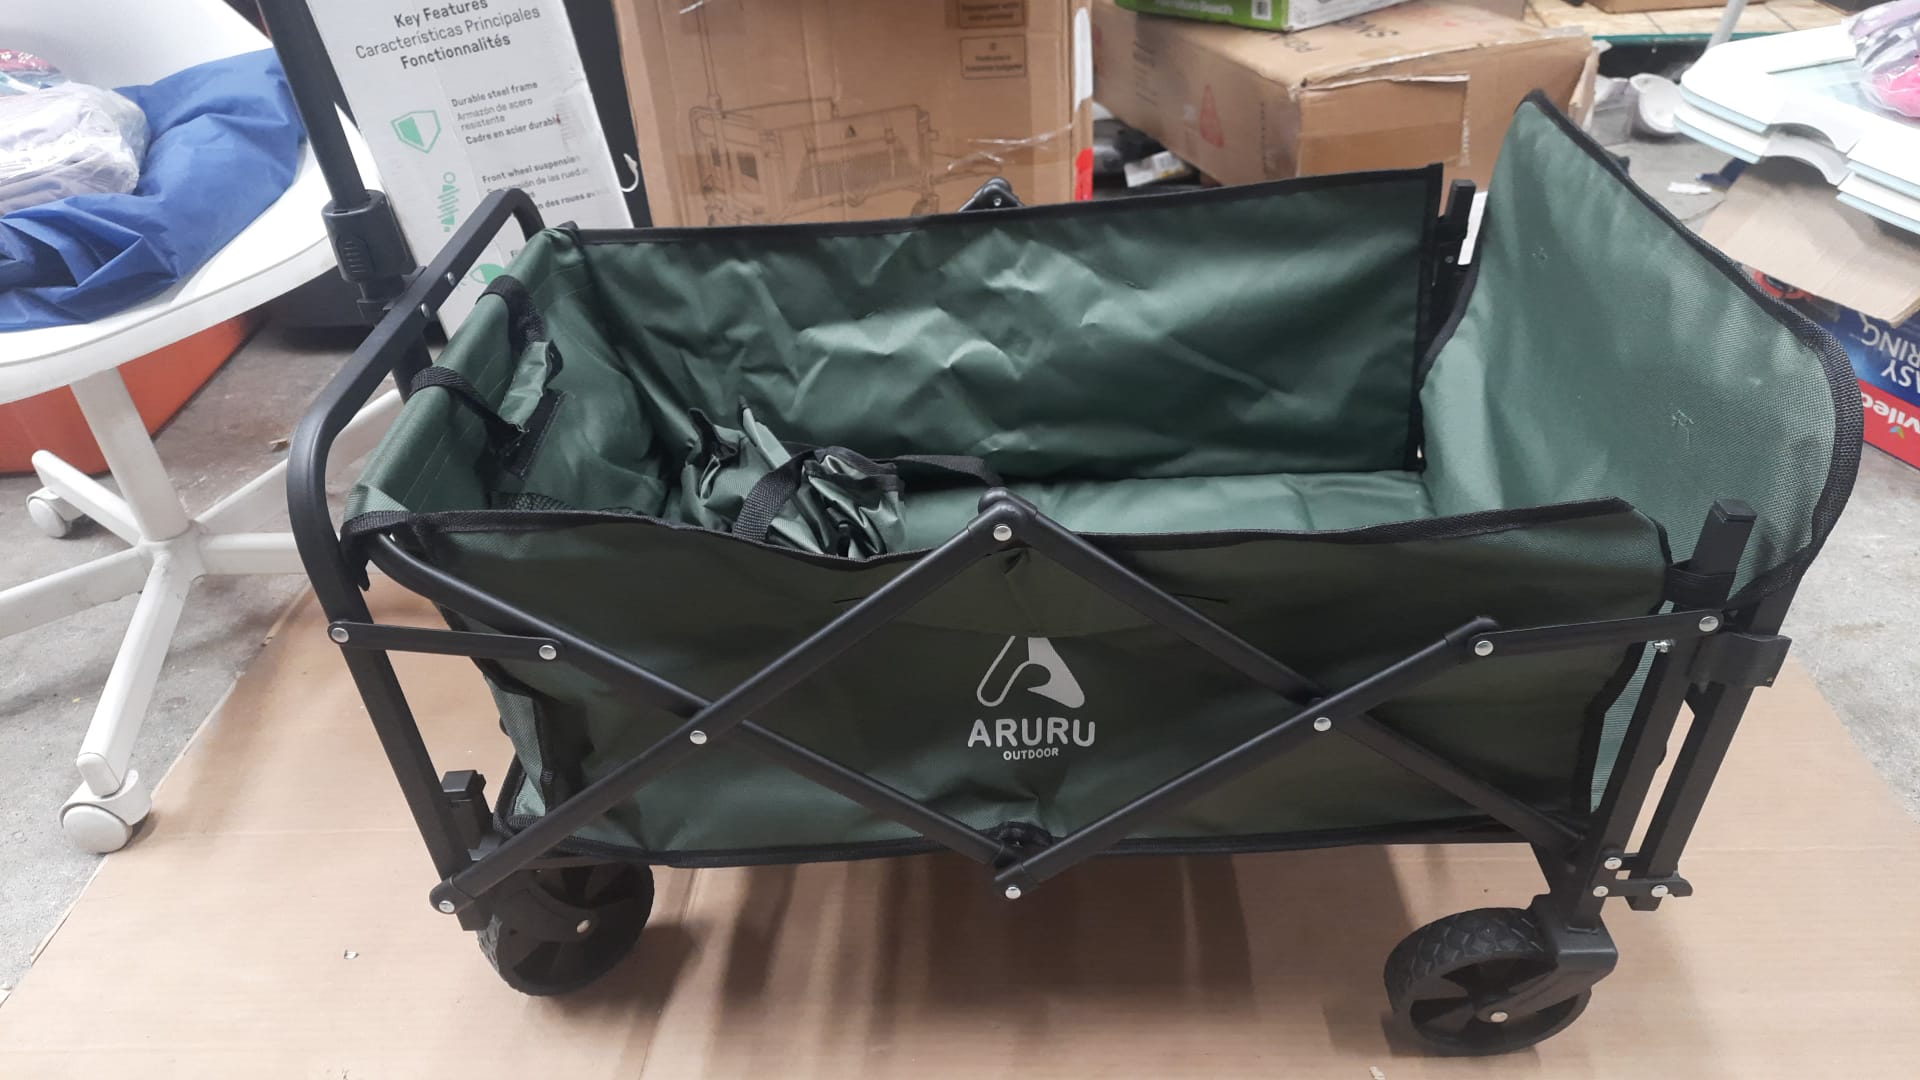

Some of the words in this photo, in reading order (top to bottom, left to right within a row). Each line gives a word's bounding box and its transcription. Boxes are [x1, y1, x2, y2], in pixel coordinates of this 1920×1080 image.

[394, 13, 421, 28] Key
[423, 0, 489, 21] Features
[355, 24, 464, 59] Características
[464, 6, 541, 33] Principales
[400, 33, 511, 69] Fonctionnalités
[451, 93, 486, 107] Durable
[487, 87, 510, 99] steel
[510, 82, 538, 94] frame
[465, 132, 492, 144] Cadre
[493, 130, 504, 139] en
[505, 123, 527, 135] acier
[481, 172, 506, 184] Front
[507, 165, 533, 177] wheel
[967, 717, 1096, 747] ARURU
[1003, 747, 1059, 760] OUTDOOR
